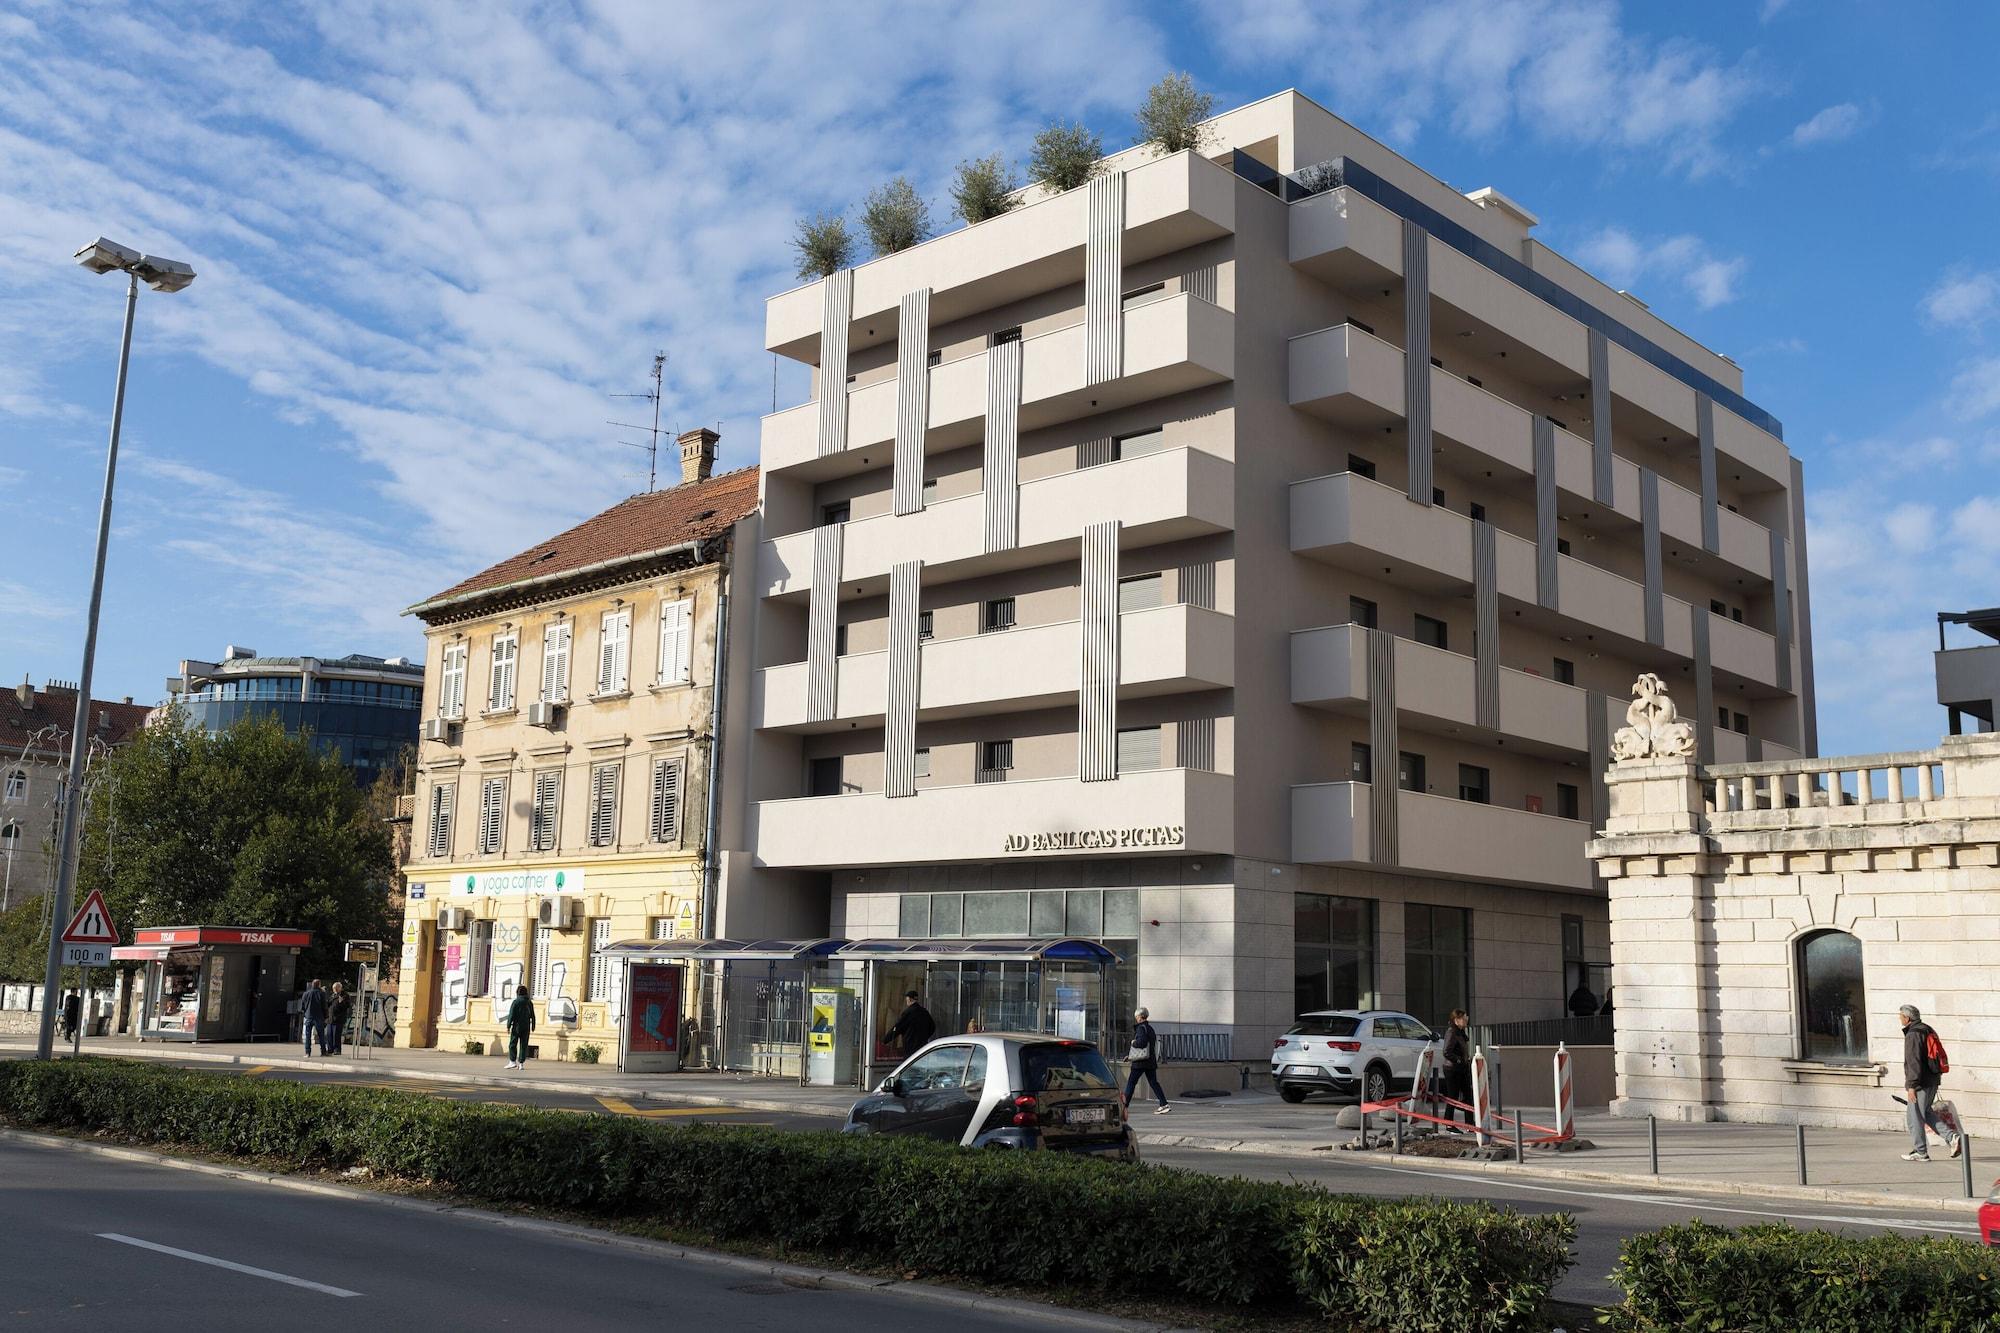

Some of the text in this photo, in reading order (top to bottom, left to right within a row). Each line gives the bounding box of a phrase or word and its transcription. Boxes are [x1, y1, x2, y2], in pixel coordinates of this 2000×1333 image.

[1004, 825, 1184, 851] AD BASILICAS PICTAS
[482, 874, 548, 895] yoga corner
[160, 932, 175, 943] TISAK
[240, 932, 274, 943] TISAK
[70, 949, 104, 961] 100 m
